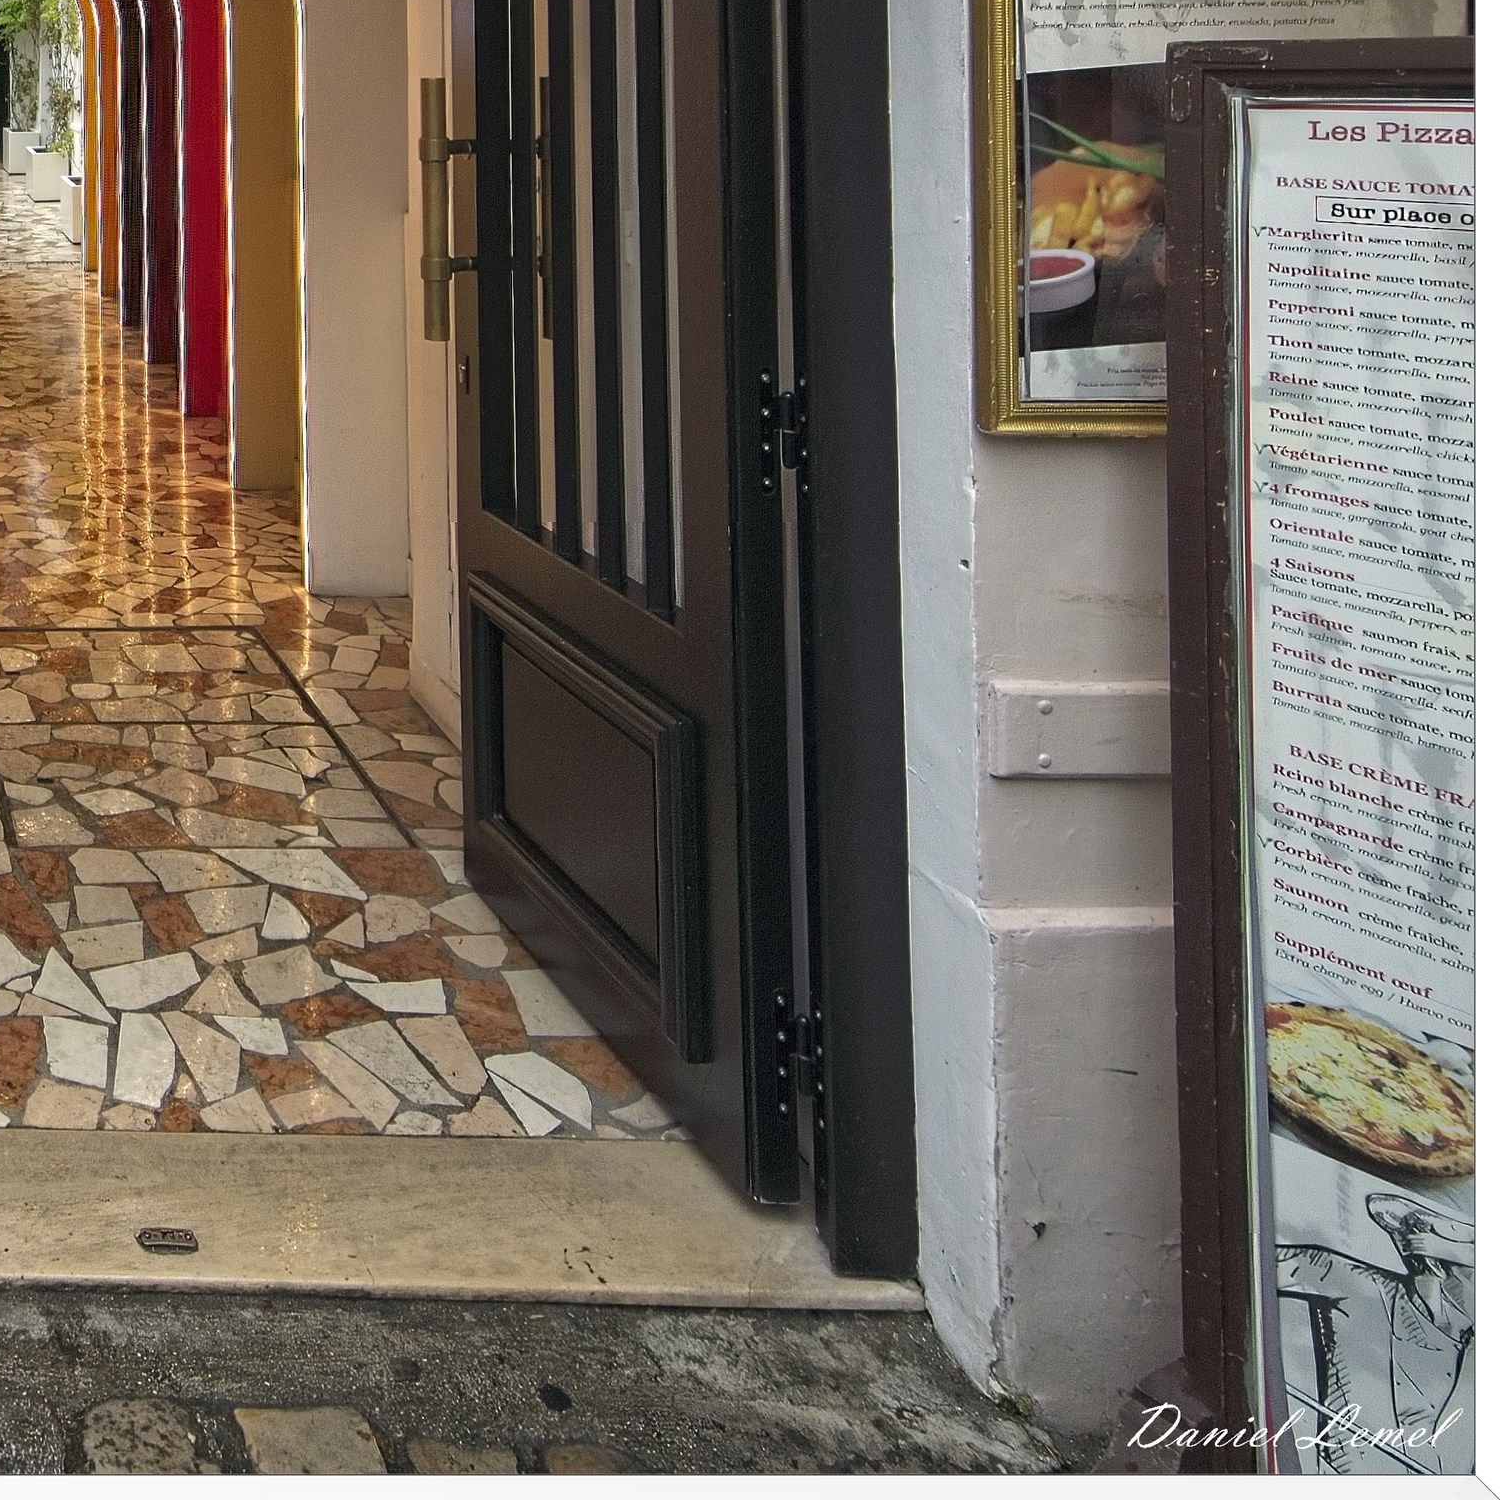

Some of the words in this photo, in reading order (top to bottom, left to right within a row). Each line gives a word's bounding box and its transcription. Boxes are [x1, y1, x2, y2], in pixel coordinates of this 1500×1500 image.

[1308, 121, 1366, 142] Les
[1277, 177, 1328, 189] BASE
[1332, 178, 1400, 193] SAUCE
[1406, 182, 1474, 196] TOMA
[1331, 203, 1376, 219] Sur
[1382, 204, 1451, 226] place
[1268, 227, 1363, 244] Margherita
[1268, 264, 1371, 281] Napolitaine
[1268, 299, 1354, 319] Pepperoni
[1268, 335, 1312, 350] Thon
[1268, 372, 1318, 388] Reine
[1269, 408, 1324, 426] Poulet
[1269, 444, 1388, 473] Végétarienne
[1270, 485, 1279, 494] 4
[1285, 483, 1369, 509] fromages
[1270, 518, 1354, 544] Orientale
[1270, 557, 1279, 568] 4
[1286, 558, 1355, 582] Saisons
[1271, 605, 1353, 634] Pacifique
[1272, 642, 1326, 665] Fruits
[1332, 656, 1352, 671] de
[1359, 668, 1396, 683] mer
[1272, 680, 1342, 709] Burrata
[1290, 745, 1342, 771] BASE
[1349, 763, 1428, 796] CRÈME
[1273, 764, 1323, 787] Reine
[1330, 780, 1403, 813] blanche
[1273, 802, 1403, 853] Campagnarde
[1274, 839, 1352, 875] Corbière
[1274, 878, 1349, 913] Saumon
[1275, 931, 1386, 982] Supplément
[1392, 977, 1432, 999] œuf
